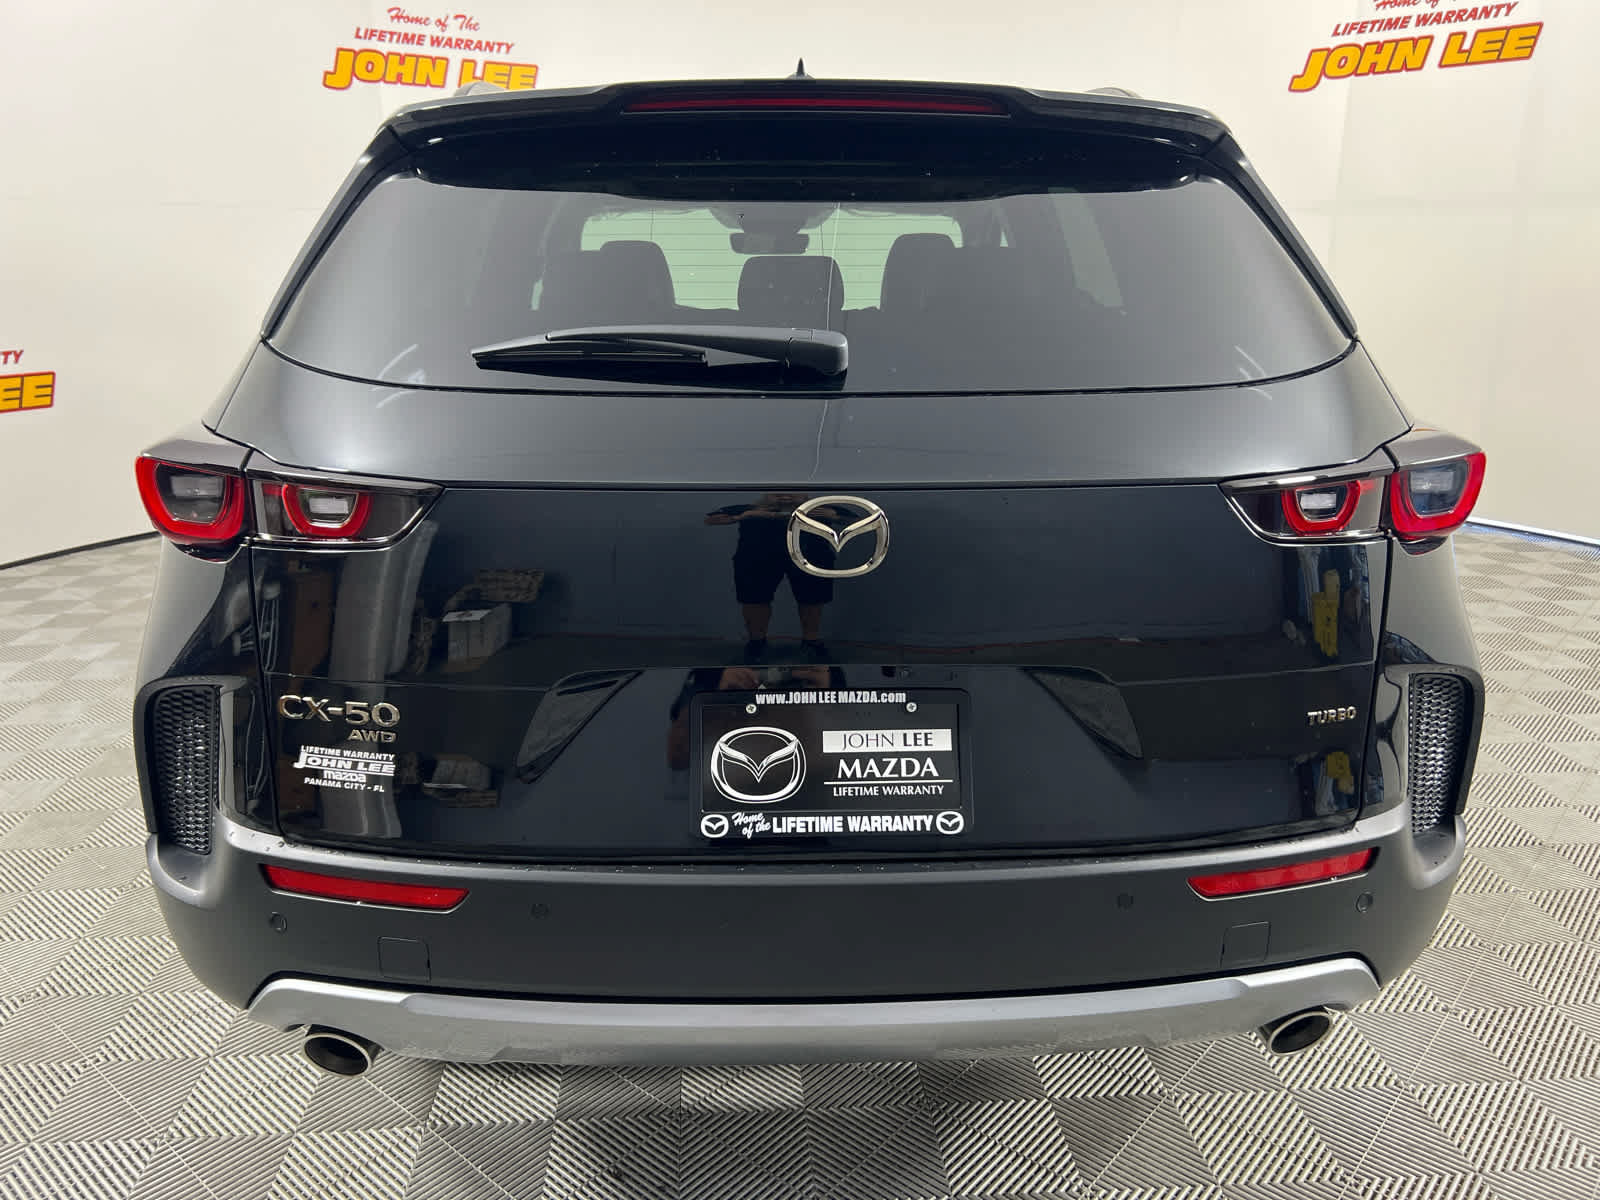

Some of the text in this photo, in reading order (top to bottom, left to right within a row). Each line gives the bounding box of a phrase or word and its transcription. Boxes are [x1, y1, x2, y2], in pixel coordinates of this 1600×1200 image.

[387, 7, 480, 32] Home of The
[1331, 1, 1519, 37] LIFETIME WARRANTY
[354, 27, 515, 54] LIFETIME WARRANTY
[1288, 21, 1544, 92] JOHN LEE
[323, 47, 538, 90] JOHN LEE
[818, 691, 837, 704] LEE
[838, 691, 906, 703] MAZDA.com
[278, 694, 400, 728] CX-50
[1307, 706, 1357, 726] TURBO
[347, 729, 397, 743] AWD
[842, 732, 934, 750] JOHN LEE
[293, 752, 396, 774] JOHN LEE
[300, 745, 395, 761] LIFETIME WARRANTY
[837, 757, 939, 779] MAZDA
[304, 777, 342, 789] PANAMA
[344, 782, 366, 791] CITY
[373, 785, 385, 793] FL
[833, 784, 945, 797] LIFETIME WARRANTY
[732, 811, 764, 826] Home
[742, 818, 771, 839] of the
[772, 814, 934, 833] LIFETIME WARRANTY
